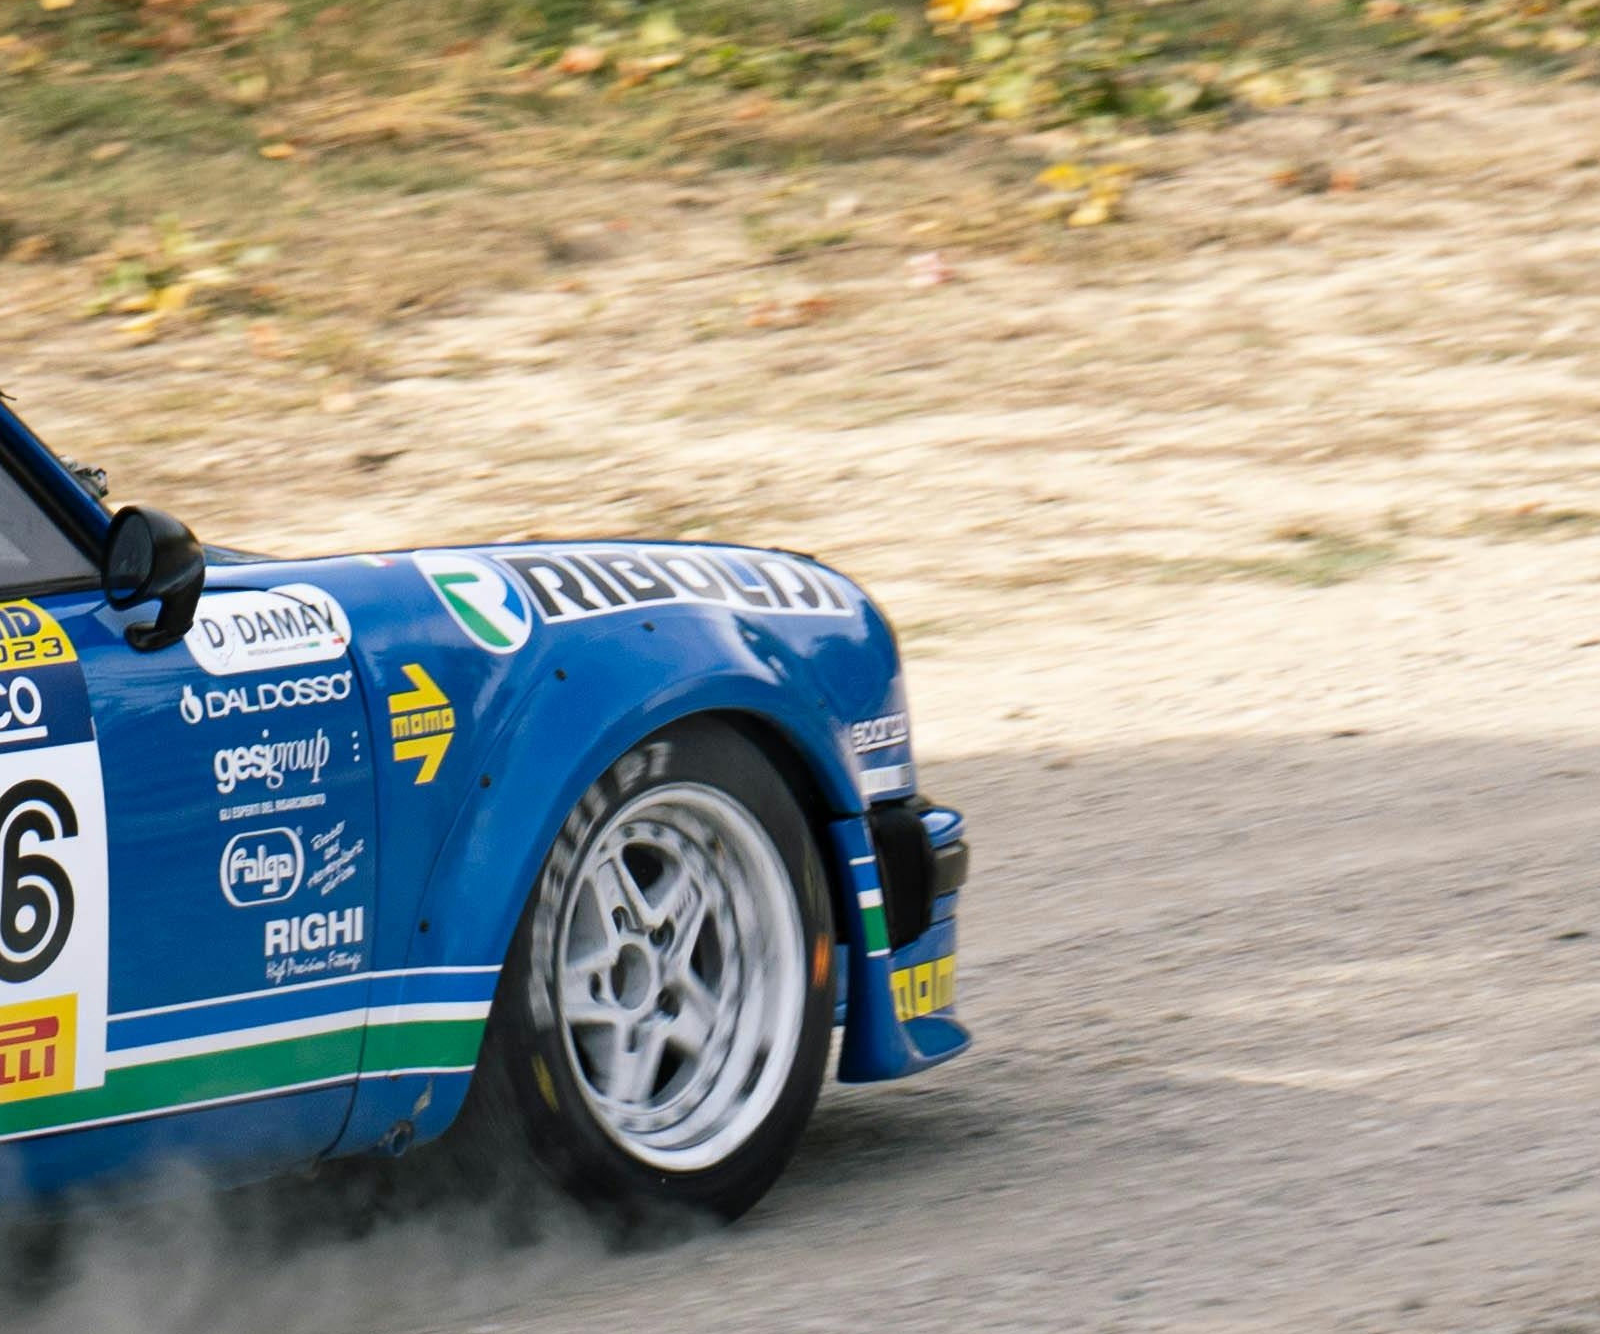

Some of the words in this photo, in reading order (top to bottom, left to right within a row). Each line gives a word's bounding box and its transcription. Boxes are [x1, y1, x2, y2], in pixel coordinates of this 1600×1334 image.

[505, 553, 848, 618] RIBOLDI
[205, 673, 351, 718] DALDOSSO
[391, 707, 455, 739] momo
[214, 728, 330, 794] gesigroup
[265, 906, 364, 957] RIGHI
